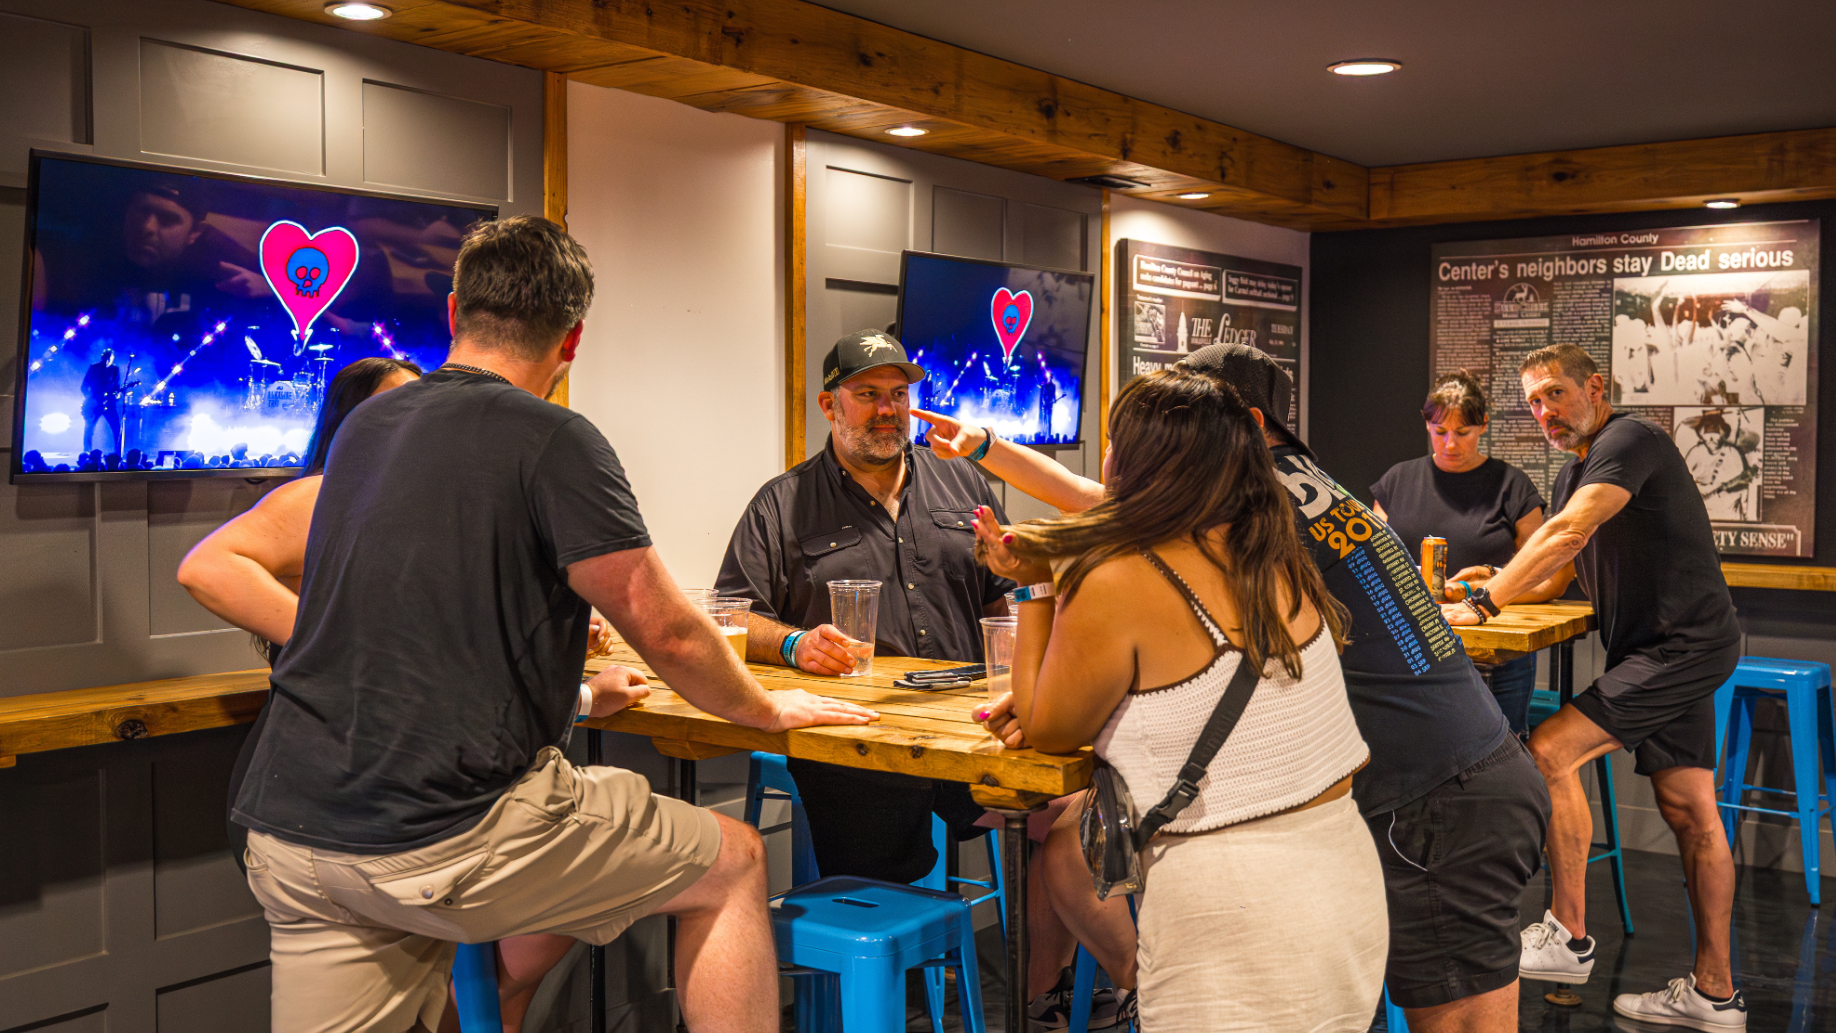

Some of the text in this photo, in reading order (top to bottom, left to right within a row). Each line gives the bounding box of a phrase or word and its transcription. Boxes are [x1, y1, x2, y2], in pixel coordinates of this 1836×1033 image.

[1572, 232, 1659, 246] Hamilton County
[1438, 248, 1794, 282] Center's neighbors stay Dead serious
[1191, 318, 1213, 337] THE
[1132, 356, 1162, 375] Heavy
[1308, 517, 1335, 542] US
[1328, 510, 1387, 559] 2011
[1740, 531, 1794, 549] SENSE"
